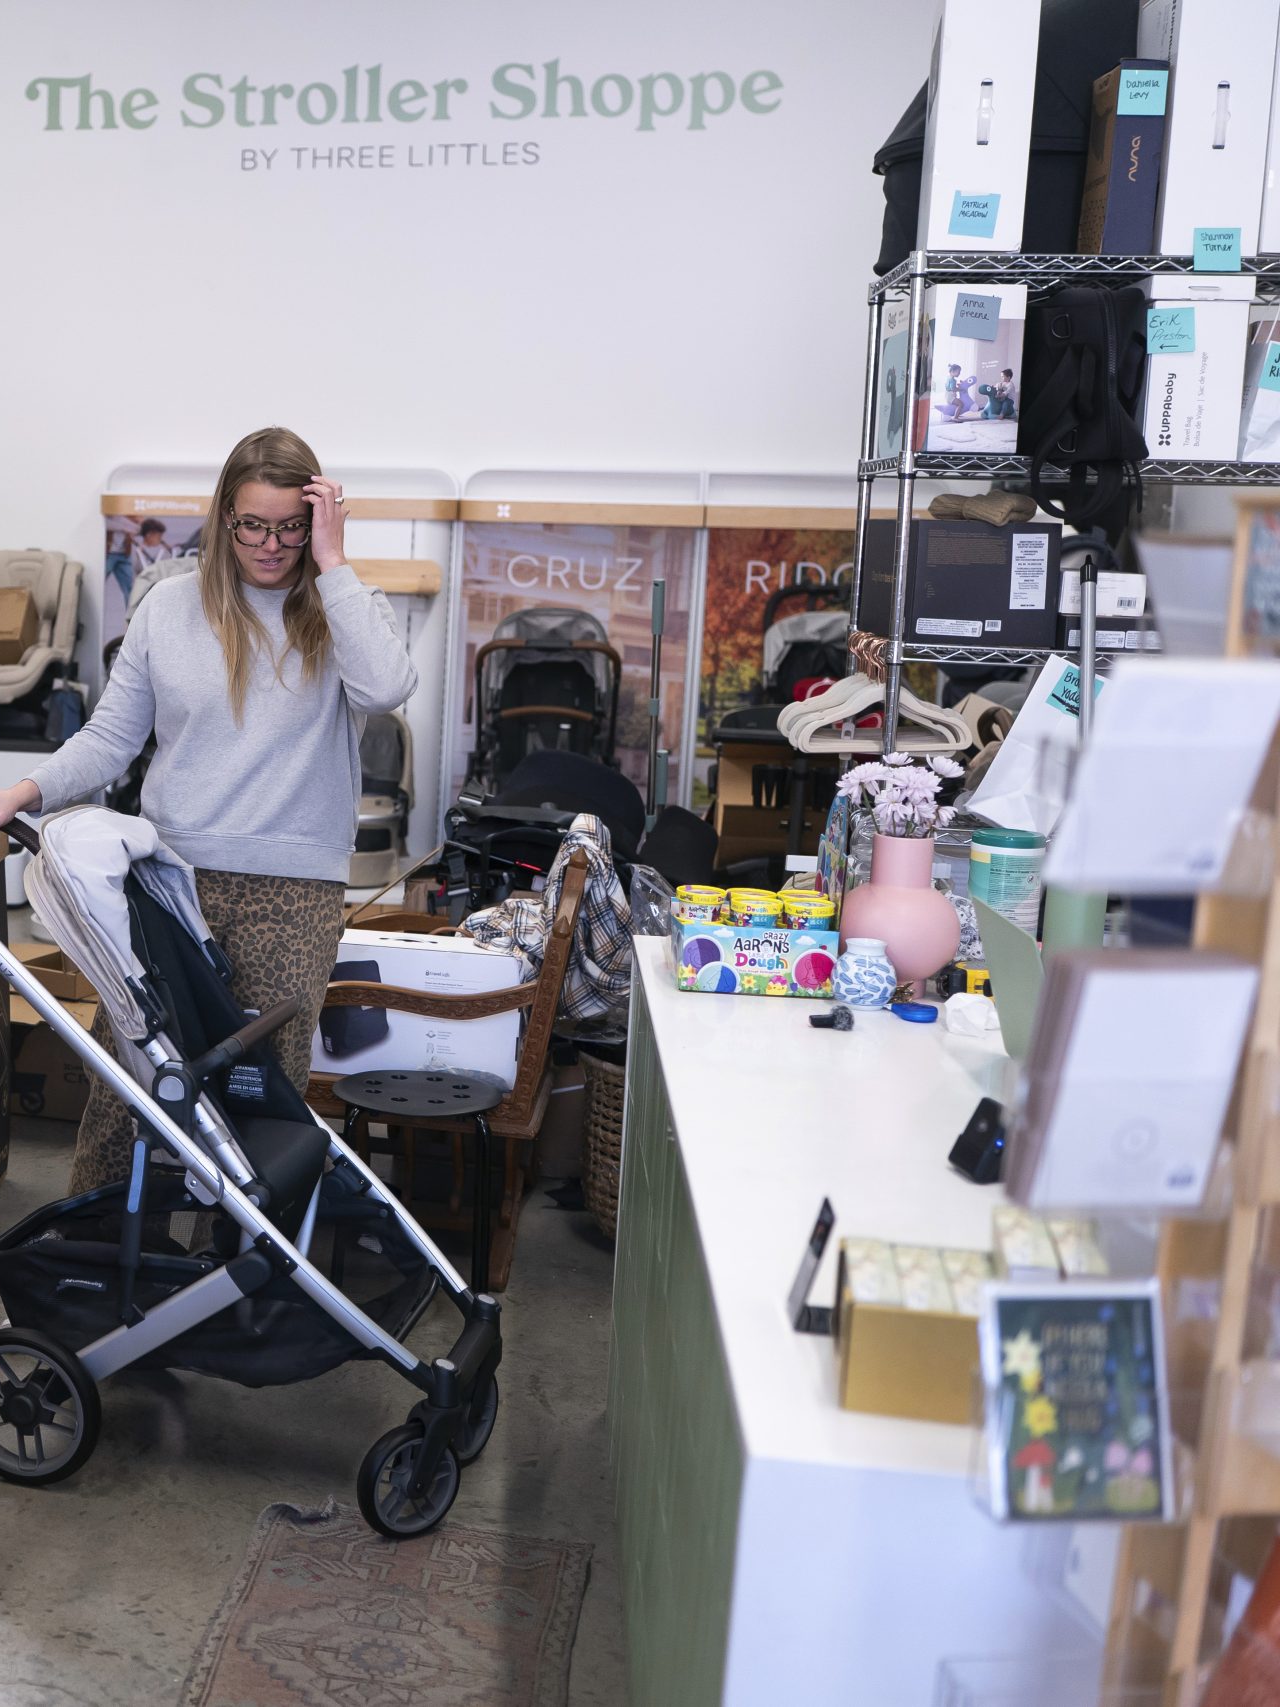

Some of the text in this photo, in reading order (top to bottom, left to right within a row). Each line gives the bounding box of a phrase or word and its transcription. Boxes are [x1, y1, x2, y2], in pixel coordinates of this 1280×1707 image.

[24, 57, 785, 132] The Stroller Shoppe
[241, 142, 541, 172] BY THREE LITTLES
[1128, 135, 1141, 182] nuna
[1161, 373, 1177, 433] UPPAbaby
[1183, 416, 1193, 447] Travel Bag
[506, 555, 643, 592] CRUZ
[734, 952, 788, 971] Dough
